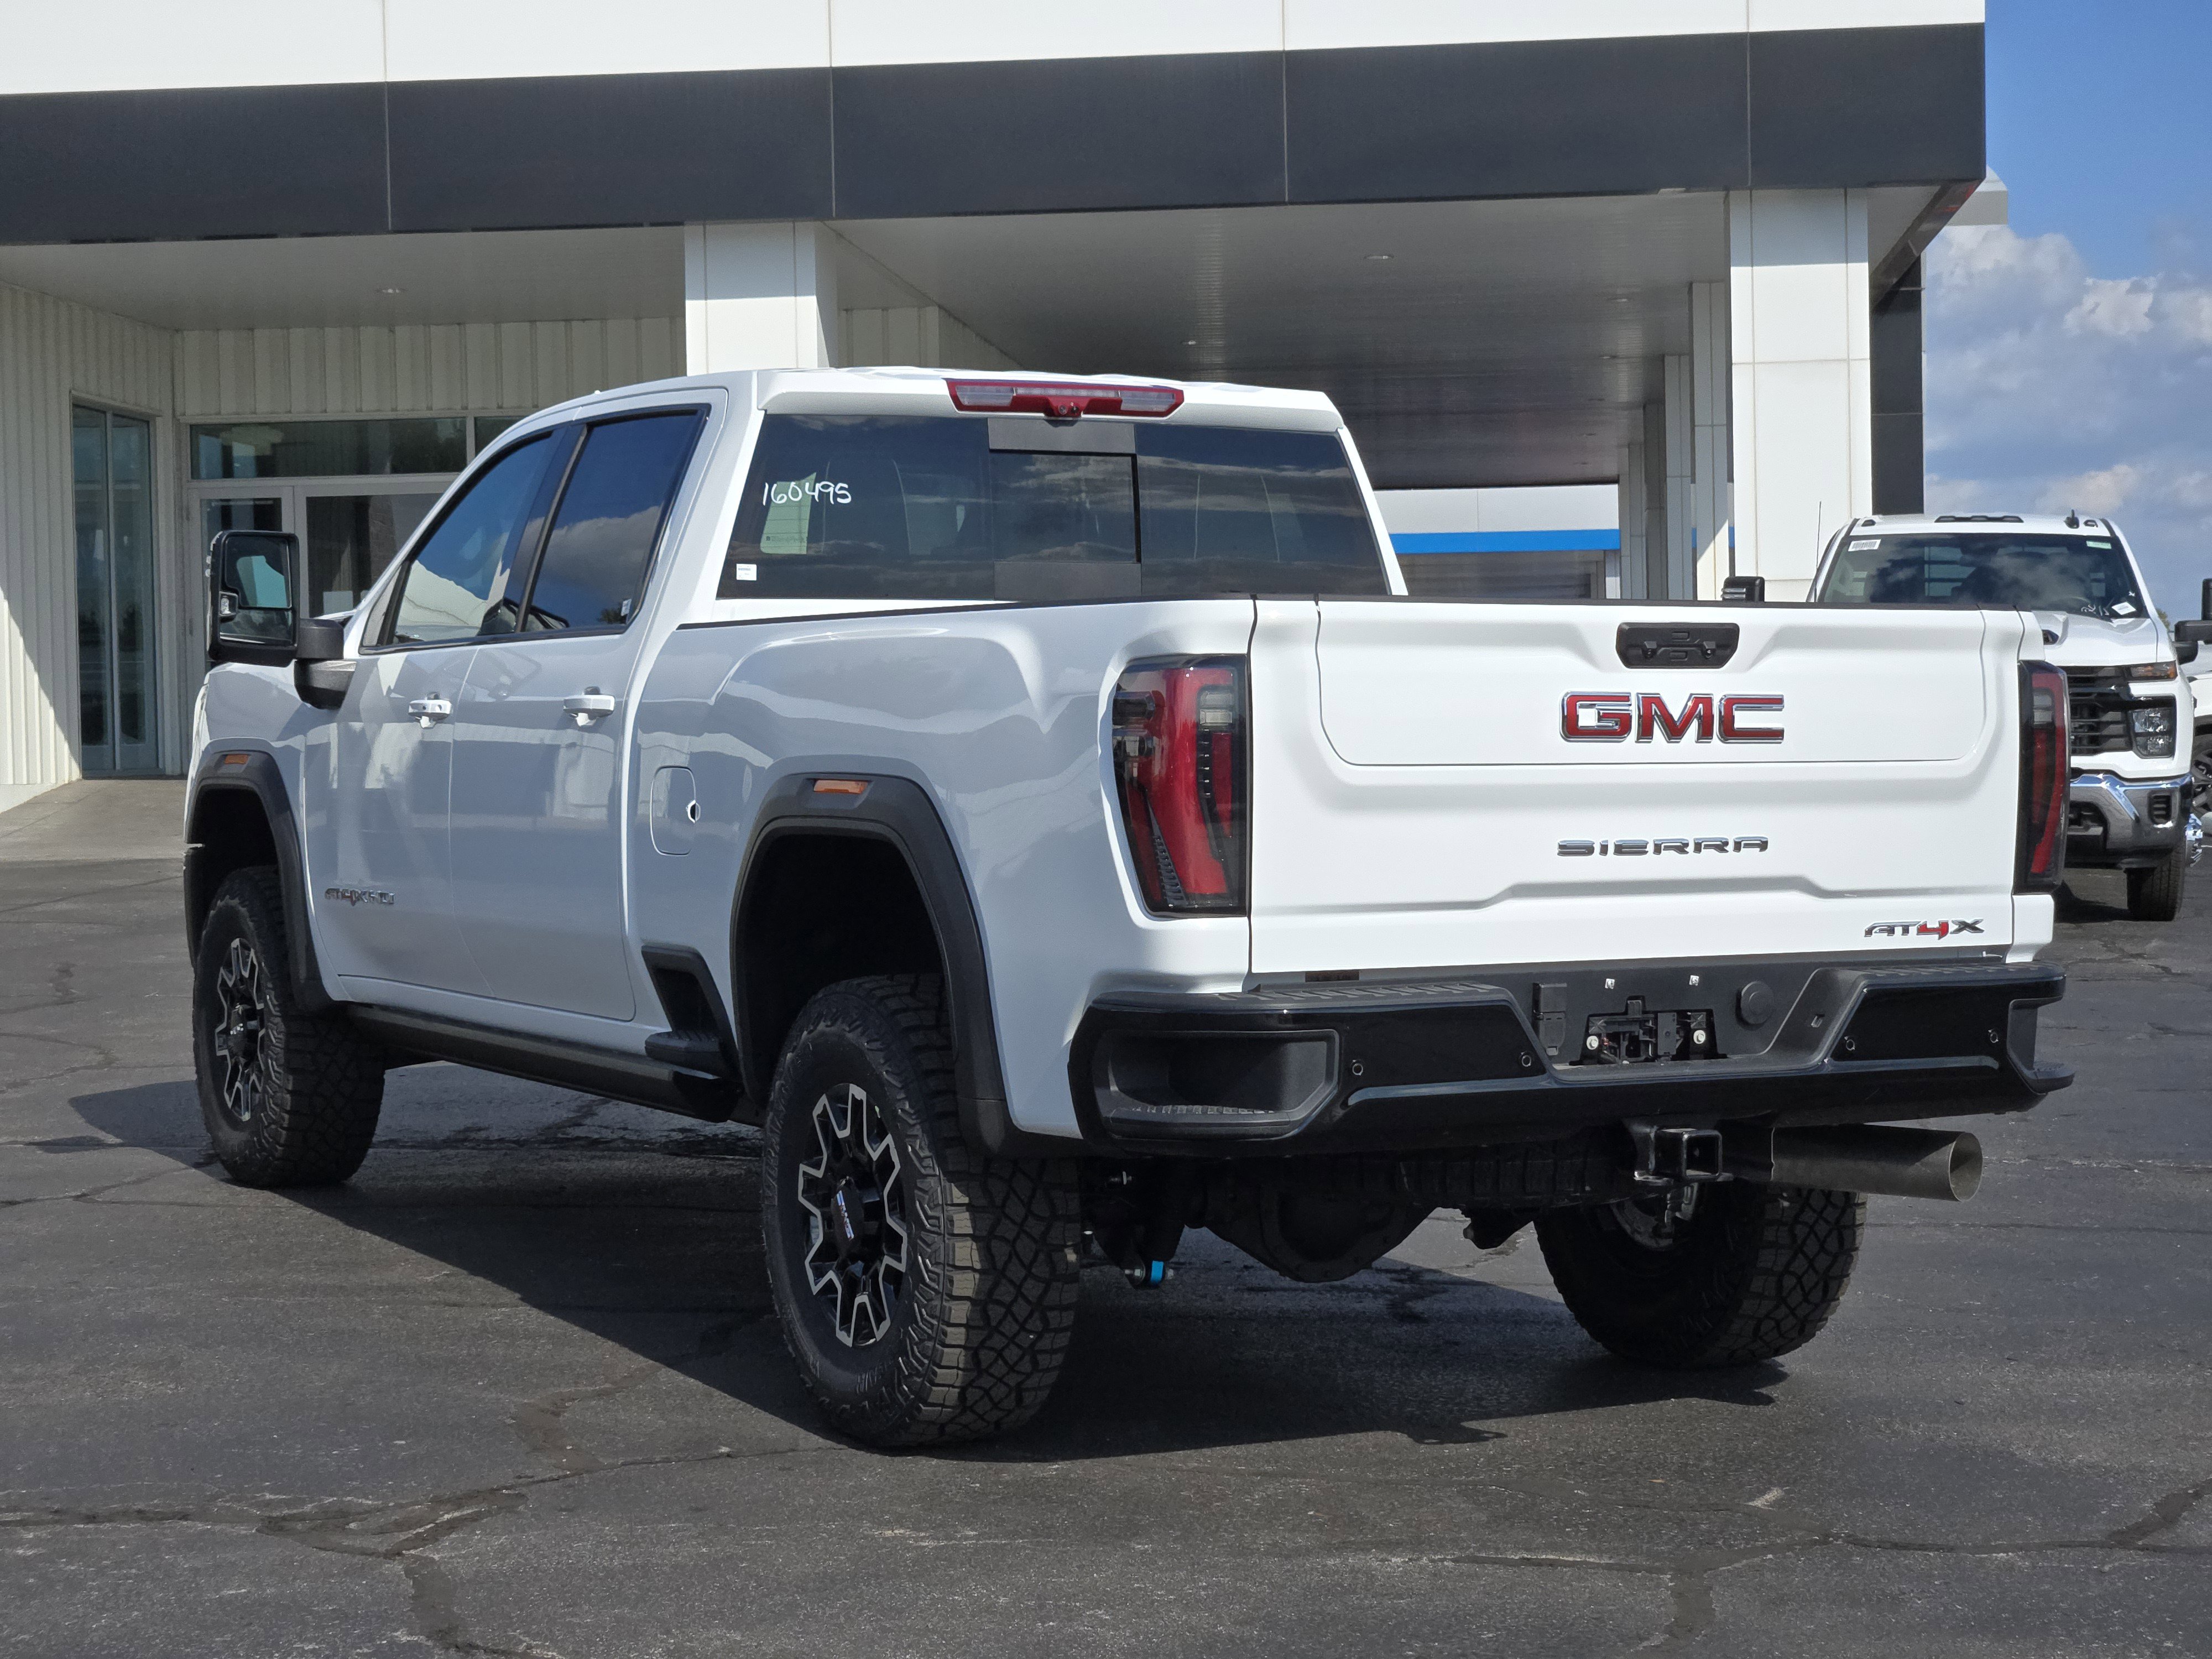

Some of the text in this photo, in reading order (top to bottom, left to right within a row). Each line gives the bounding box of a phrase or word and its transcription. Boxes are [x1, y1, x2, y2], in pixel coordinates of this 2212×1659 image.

[762, 481, 852, 506] 160495
[1559, 690, 1785, 744] GMC
[1557, 836, 1769, 857] SIERRA
[1863, 917, 1985, 941] AT4X
